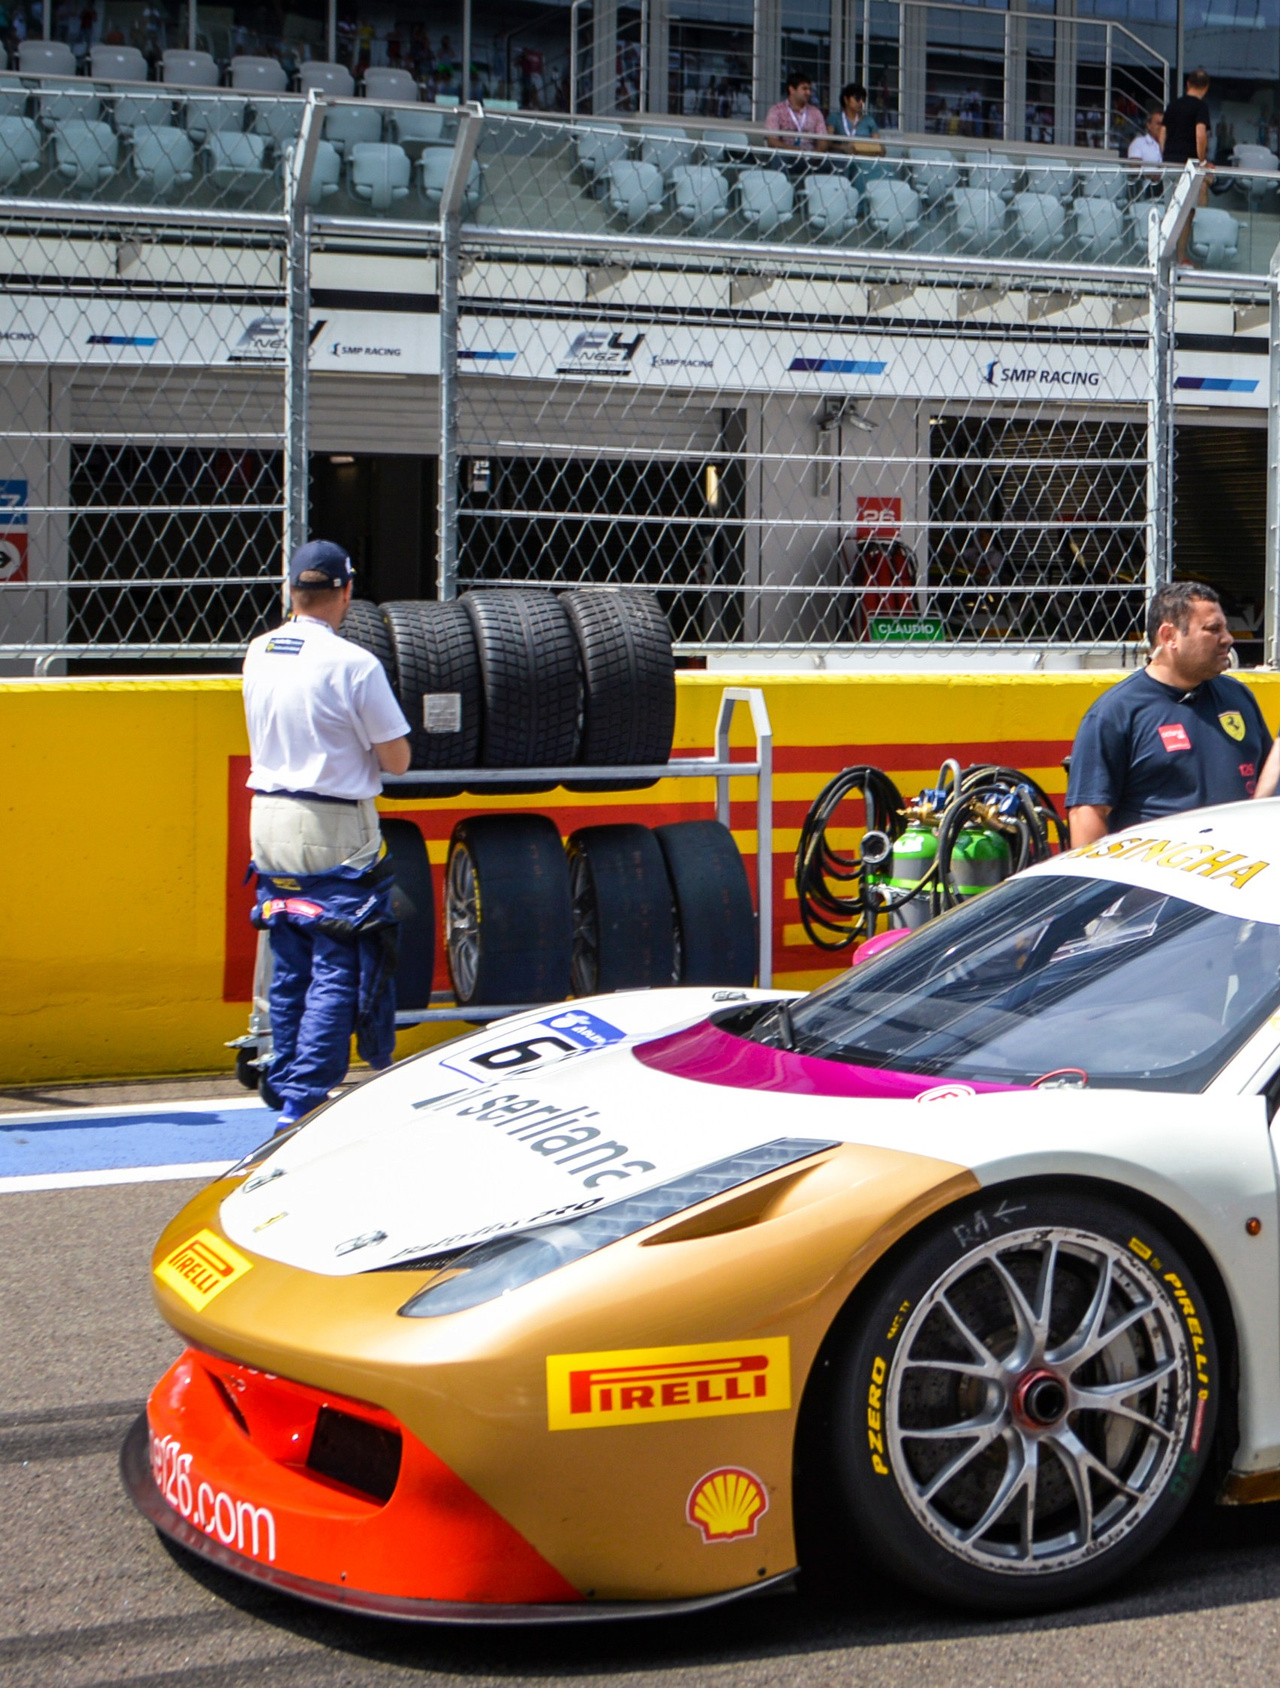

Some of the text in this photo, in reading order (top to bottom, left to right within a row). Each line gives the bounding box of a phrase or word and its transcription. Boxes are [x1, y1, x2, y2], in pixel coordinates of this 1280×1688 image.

[364, 347, 401, 357] RACING
[564, 331, 646, 361] F4
[1000, 368, 1100, 386] SMP RACING
[878, 623, 934, 635] CLAUDIO
[1087, 836, 1271, 890] SINGHA
[167, 1239, 235, 1295] PIRELLI
[1163, 1272, 1209, 1384] PIRELLI
[569, 1355, 769, 1415] PIRELLI
[867, 1356, 890, 1476] PZERO
